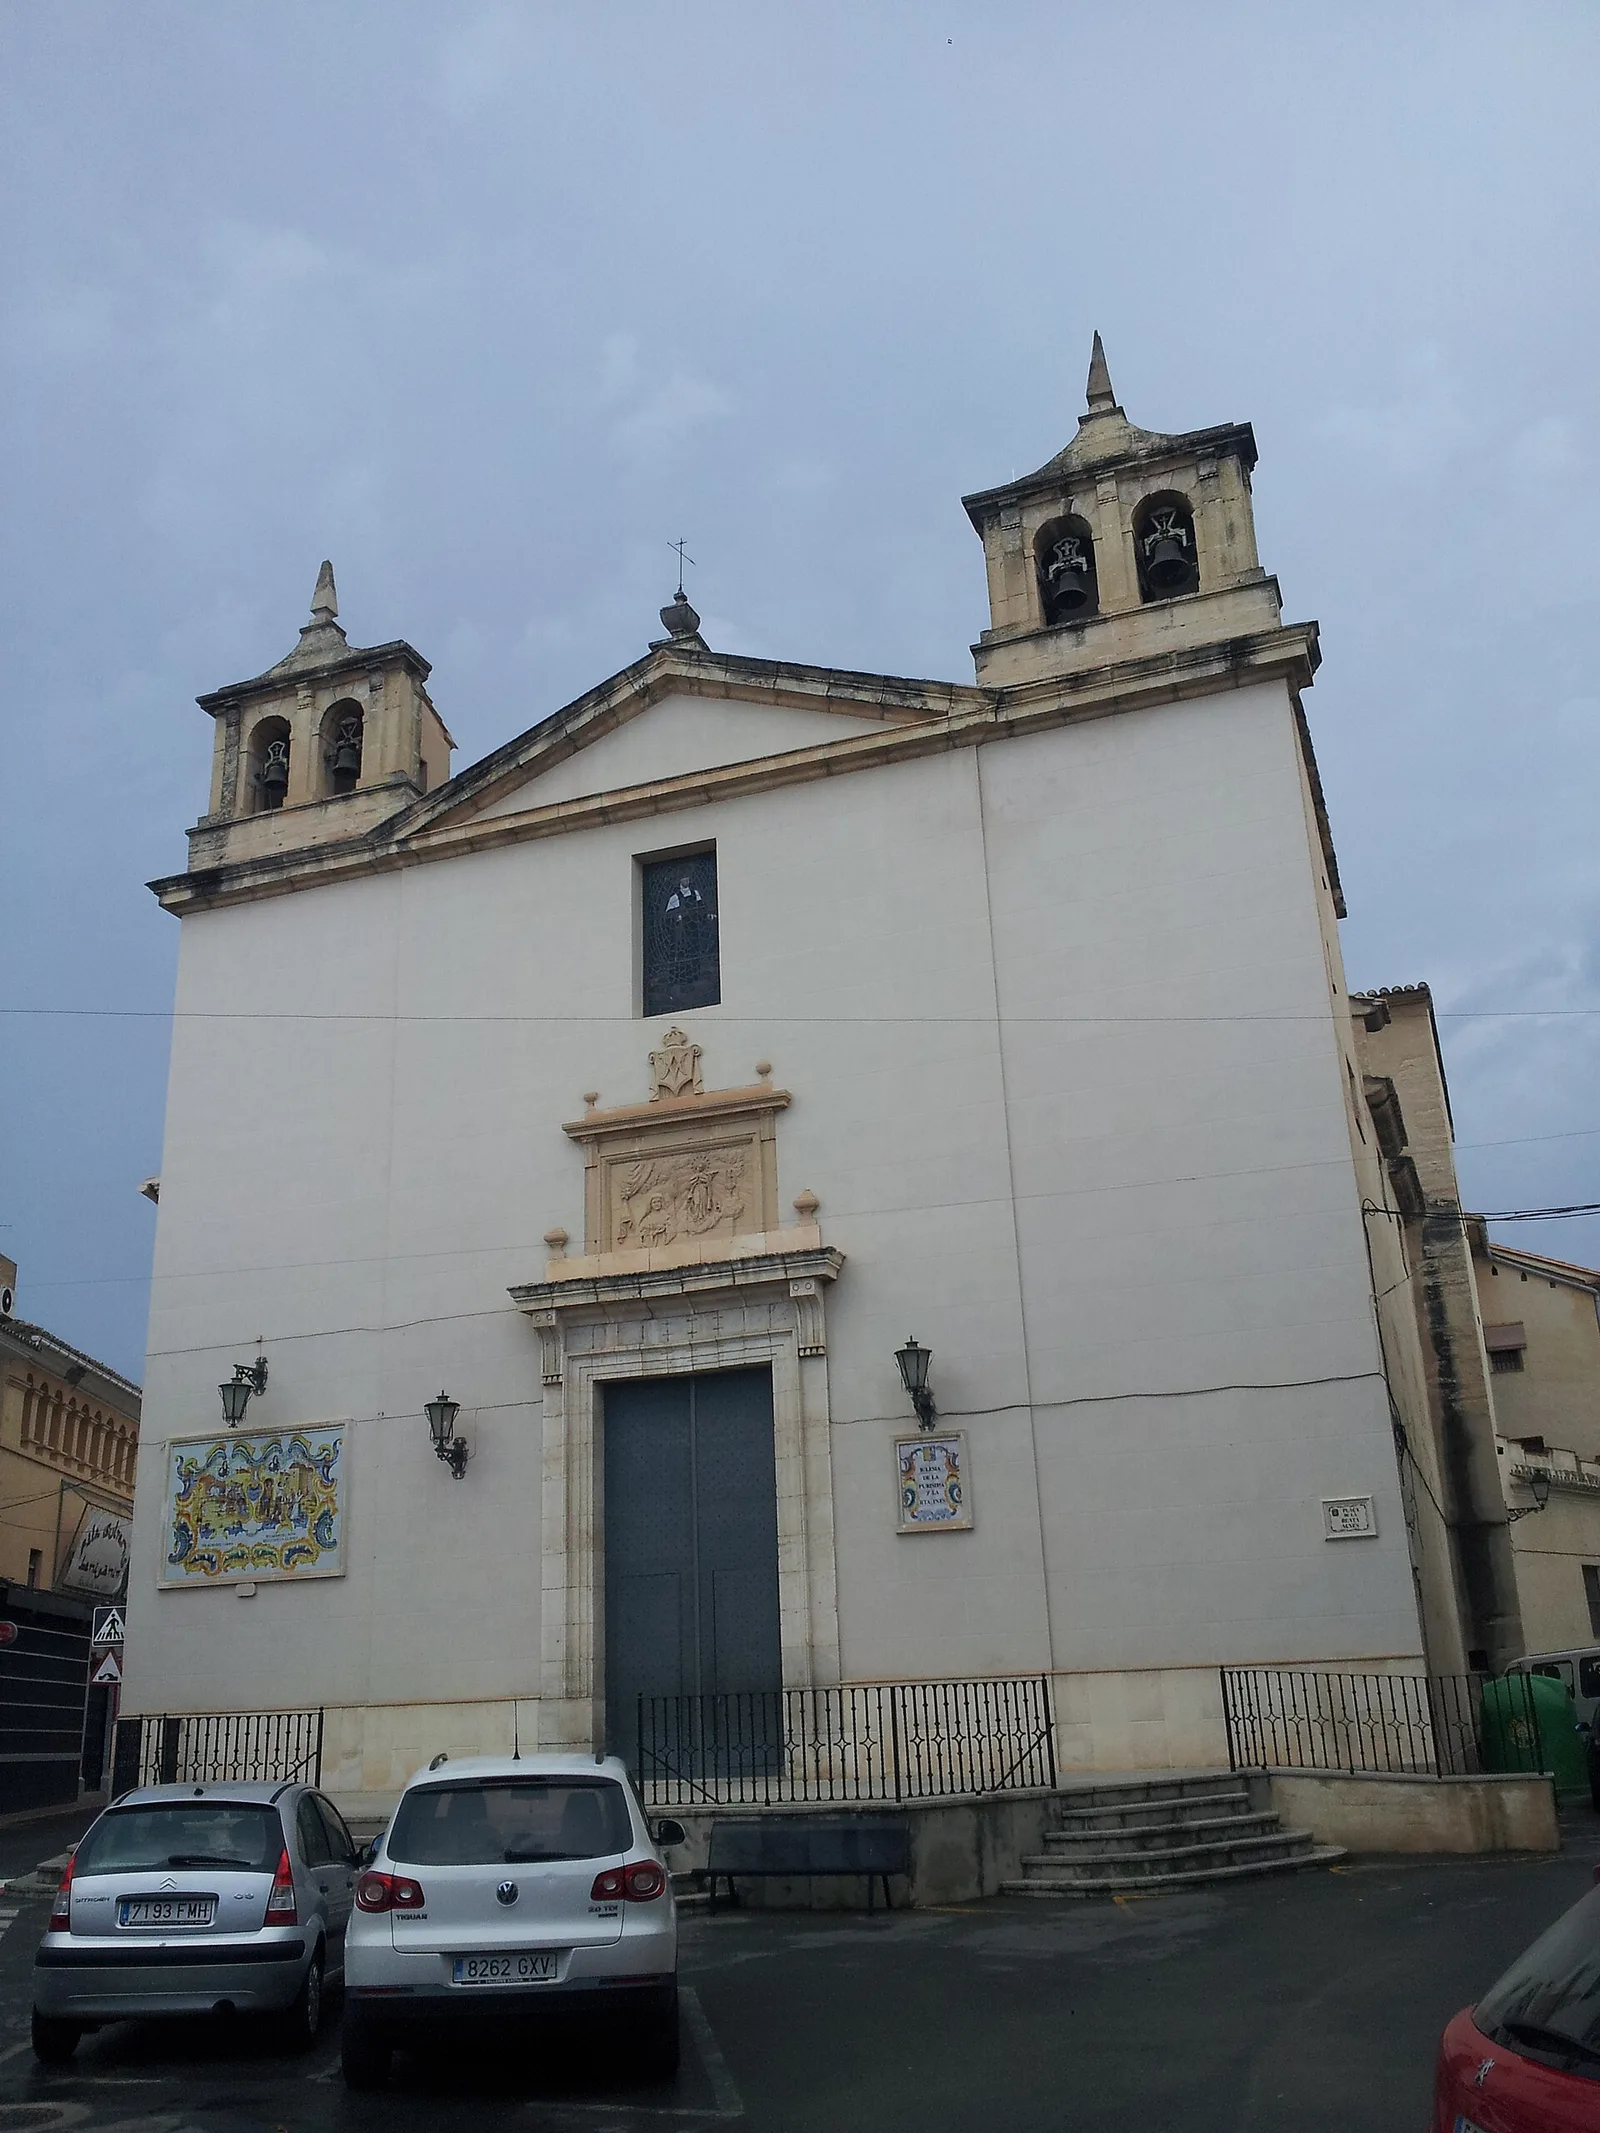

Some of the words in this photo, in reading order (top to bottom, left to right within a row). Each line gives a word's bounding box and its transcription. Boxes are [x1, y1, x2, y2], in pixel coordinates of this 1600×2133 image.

[132, 1903, 172, 1920] 7193
[176, 1902, 208, 1919] FMH
[467, 1959, 511, 1977] 8262
[518, 1957, 550, 1975] GXV
